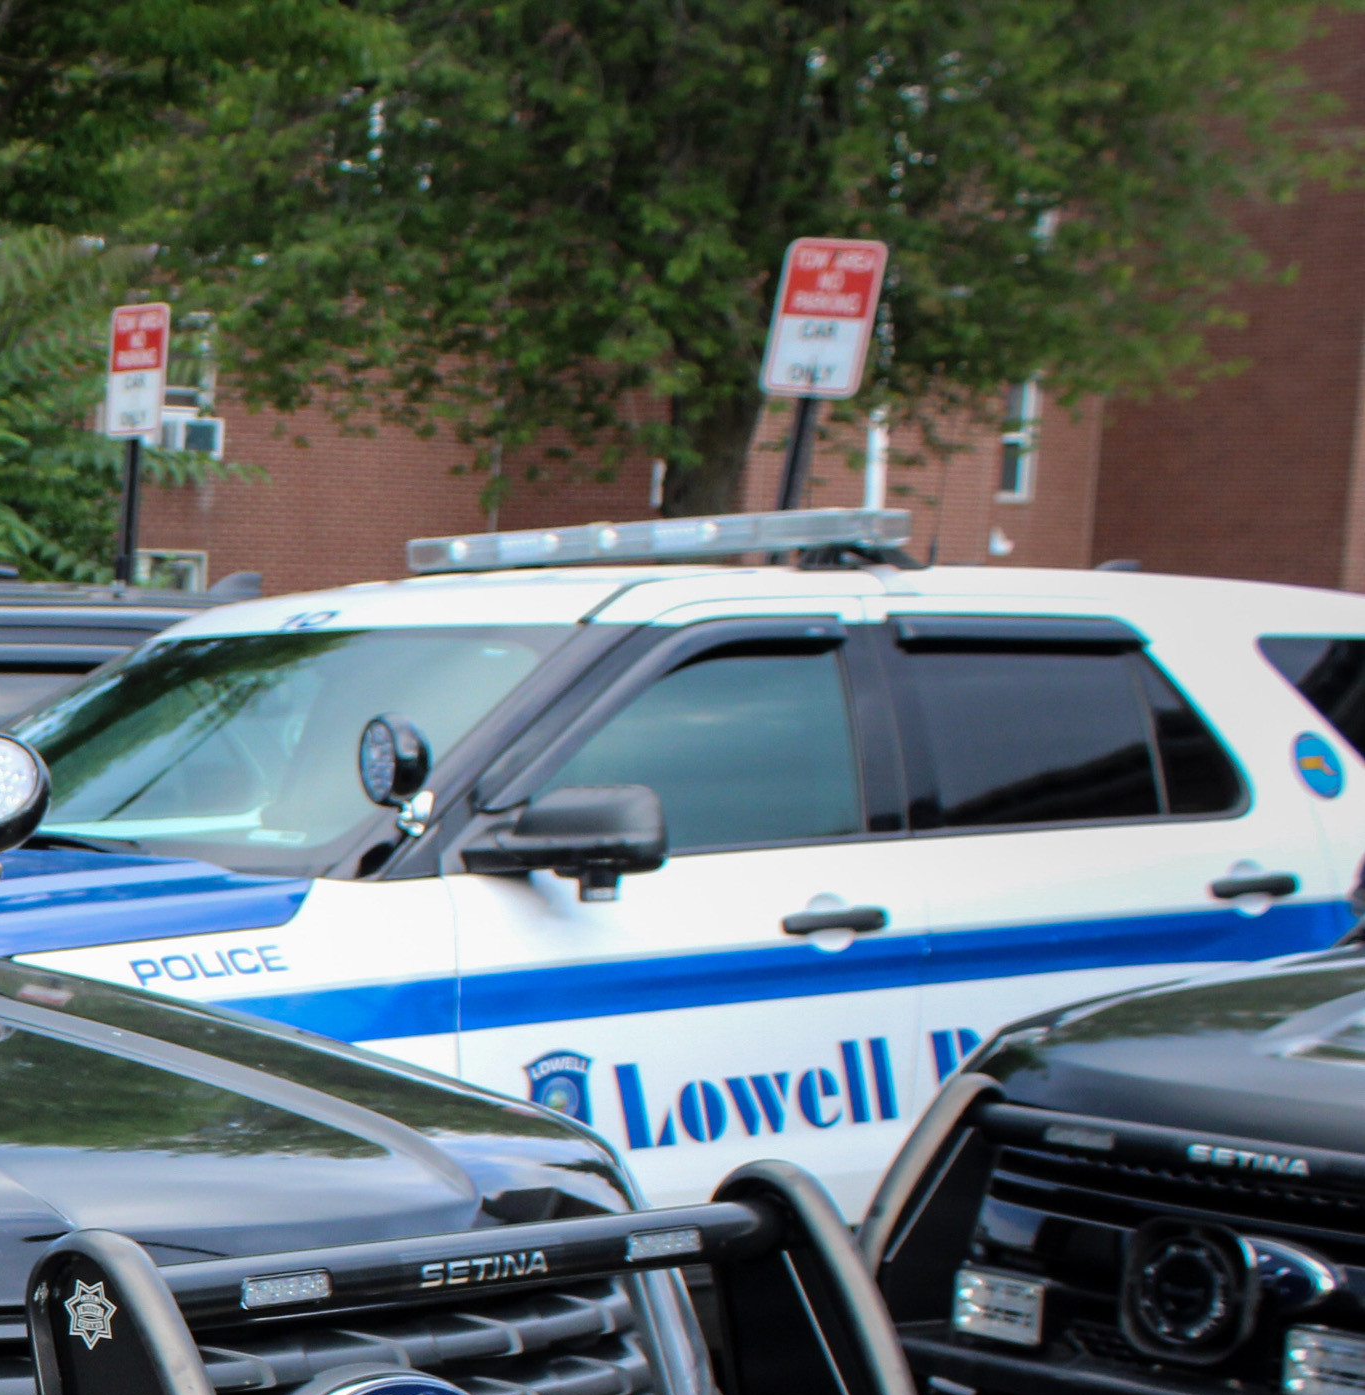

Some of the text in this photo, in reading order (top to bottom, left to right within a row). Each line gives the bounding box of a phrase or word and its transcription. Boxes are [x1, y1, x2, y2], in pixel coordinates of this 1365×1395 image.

[817, 270, 845, 290] NO
[791, 290, 863, 314] PARKING
[128, 944, 291, 987] POLICE
[531, 1055, 588, 1081] LOWELL
[613, 1036, 900, 1151] Lowell
[1187, 1143, 1311, 1177] SETINA
[419, 1250, 550, 1289] SETINA
